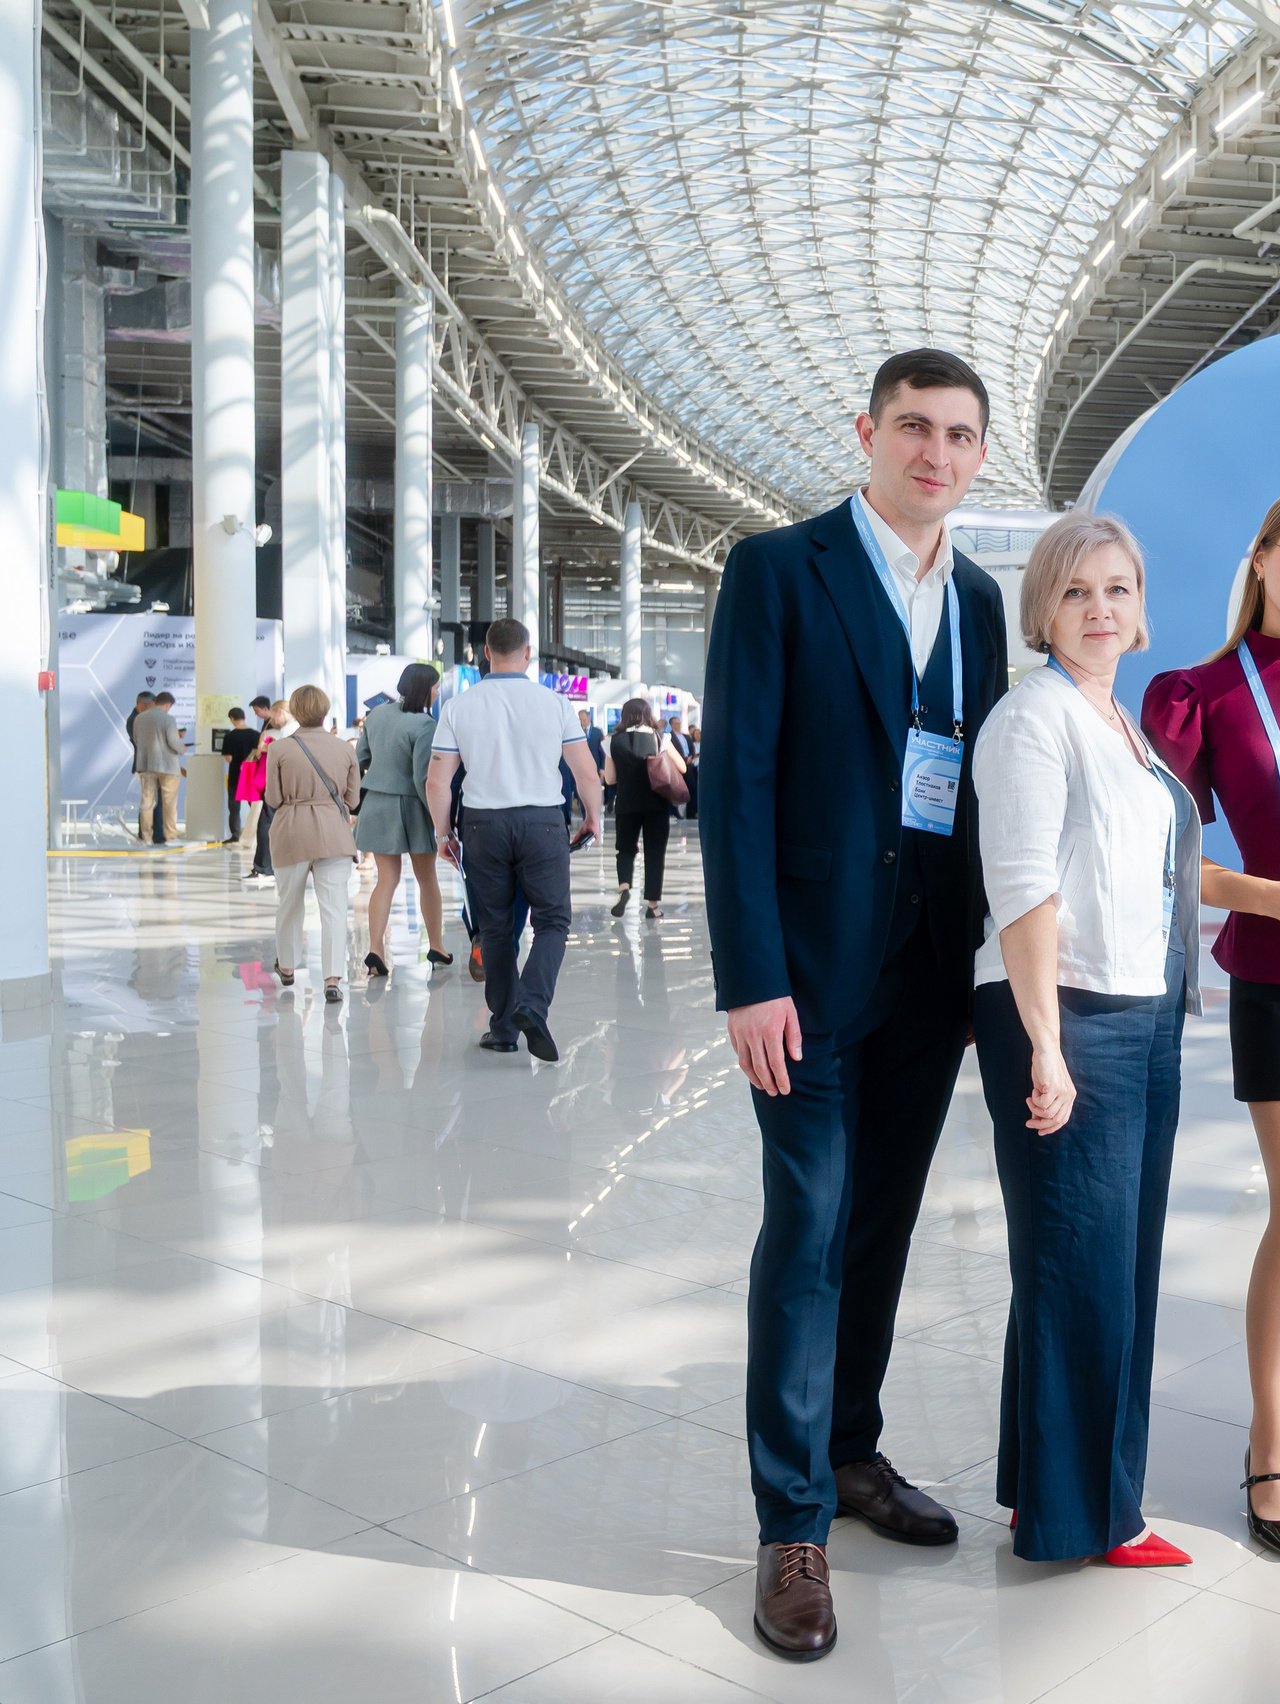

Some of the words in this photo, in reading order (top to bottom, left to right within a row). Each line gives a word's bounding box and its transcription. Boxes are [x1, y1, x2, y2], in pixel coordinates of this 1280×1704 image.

[143, 641, 176, 649] DevOps
[911, 736, 961, 755] УЧАСТНИК
[914, 786, 926, 794] Банк
